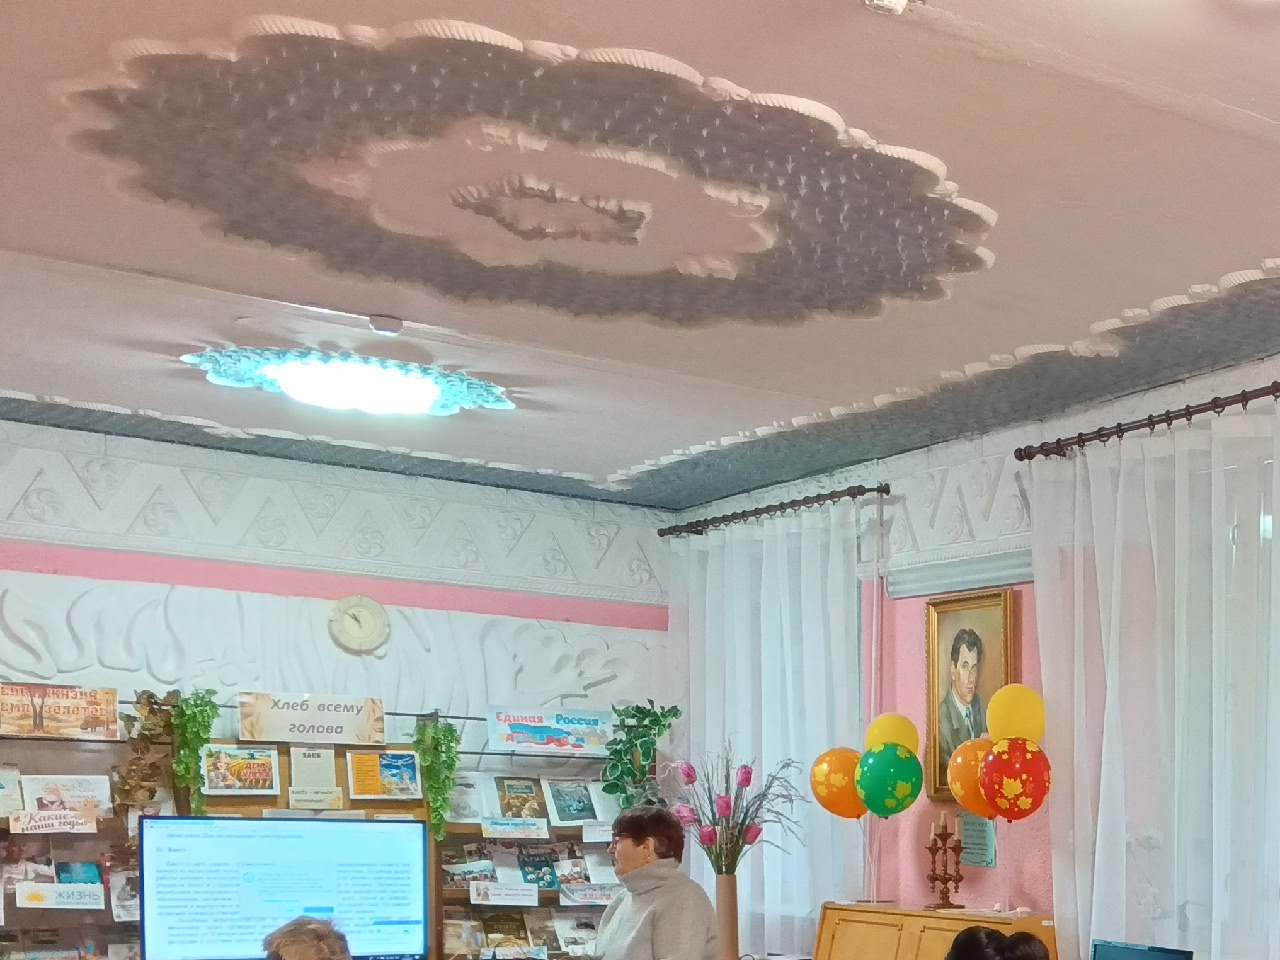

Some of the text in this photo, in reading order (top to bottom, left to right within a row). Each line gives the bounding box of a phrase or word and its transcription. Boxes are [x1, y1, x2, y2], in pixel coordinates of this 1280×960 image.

[270, 697, 364, 716] Хлеб всему
[495, 711, 544, 724] Единая
[555, 713, 599, 726] Россия
[288, 723, 344, 735] голова
[23, 812, 70, 825] Какие
[21, 822, 54, 833] наши
[55, 890, 100, 900] ЖИЗНЬ
